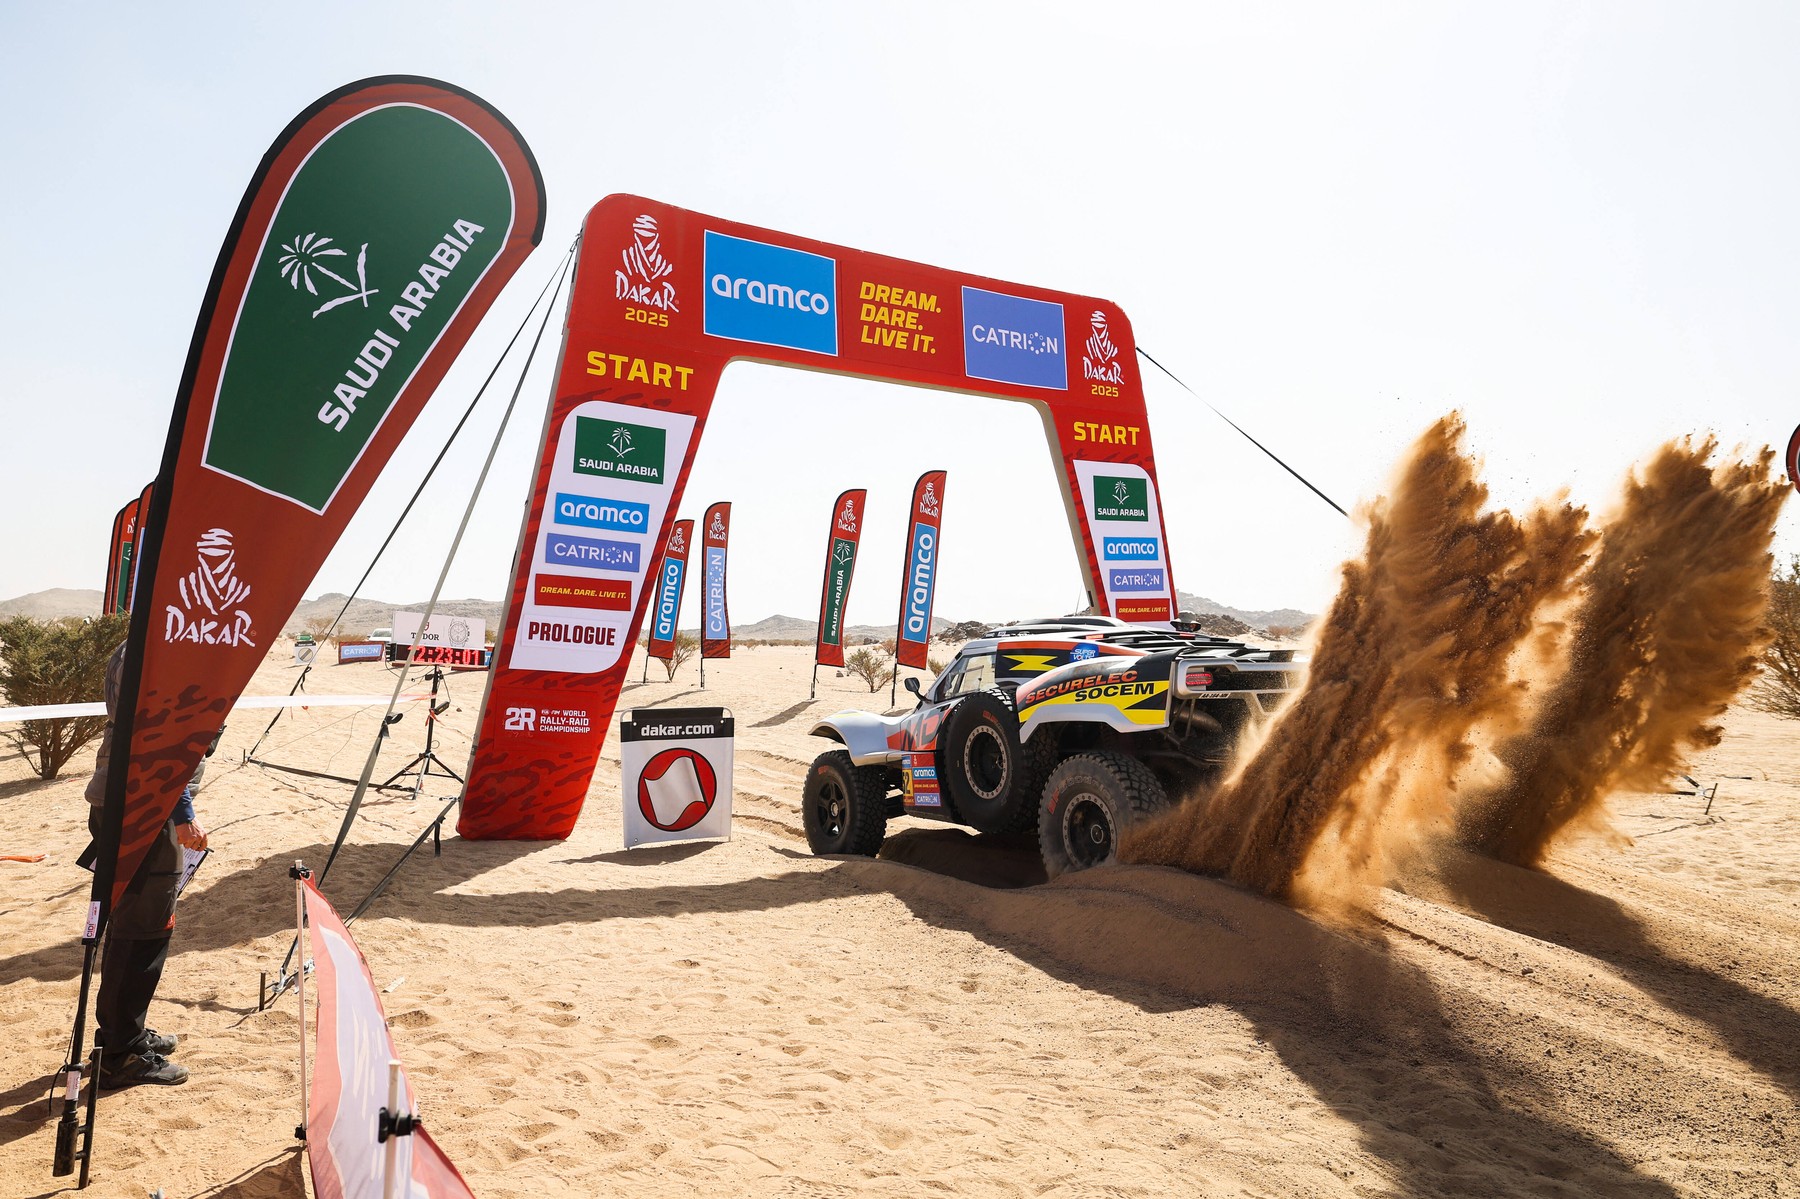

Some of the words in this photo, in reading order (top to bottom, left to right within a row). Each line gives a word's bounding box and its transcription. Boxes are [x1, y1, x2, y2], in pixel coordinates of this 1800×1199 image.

[614, 269, 680, 313] DAKAR
[711, 273, 830, 315] aramco
[859, 281, 942, 314] DREAM.
[317, 328, 400, 433] SAUDI
[389, 218, 485, 332] ARABIA
[625, 307, 669, 328] 2025
[860, 303, 923, 331] DARE.
[860, 325, 909, 351] LIVE
[914, 333, 936, 355] IT.
[971, 324, 1058, 355] CATRION
[586, 350, 694, 391] START
[1083, 356, 1125, 385] DAKAR
[1091, 384, 1119, 398] 2025
[1073, 421, 1140, 446] START
[579, 457, 613, 472] SAUDI
[616, 463, 659, 478] ARABIA
[560, 501, 644, 525] aramco
[919, 502, 939, 518] DAKAR
[1097, 507, 1118, 516] SAUDI
[1119, 508, 1146, 517] ARABIA
[838, 518, 857, 533] DAKAR
[554, 542, 634, 564] CATRION
[1107, 541, 1155, 555] aramco
[834, 569, 844, 606] ARABIA
[908, 533, 934, 633] aramco
[1114, 573, 1160, 586] CATRION
[540, 586, 572, 595] DREAM.
[573, 588, 598, 597] DARE.
[598, 590, 616, 599] LIVE
[659, 564, 679, 635] aramco
[709, 554, 724, 632] CATRION
[165, 604, 256, 647] DAKAR
[528, 621, 616, 646] PROLOGUE
[831, 607, 839, 637] SAUDI
[411, 632, 440, 641] TDOR
[1025, 670, 1139, 705] SECURELEC
[1074, 682, 1155, 702] SOCEM
[504, 707, 537, 731] 2R
[539, 725, 591, 733] CHAMPIONSHIP
[540, 716, 589, 726] RALLY-RAID
[640, 724, 715, 737] dakar.com
[913, 769, 936, 777] aramco
